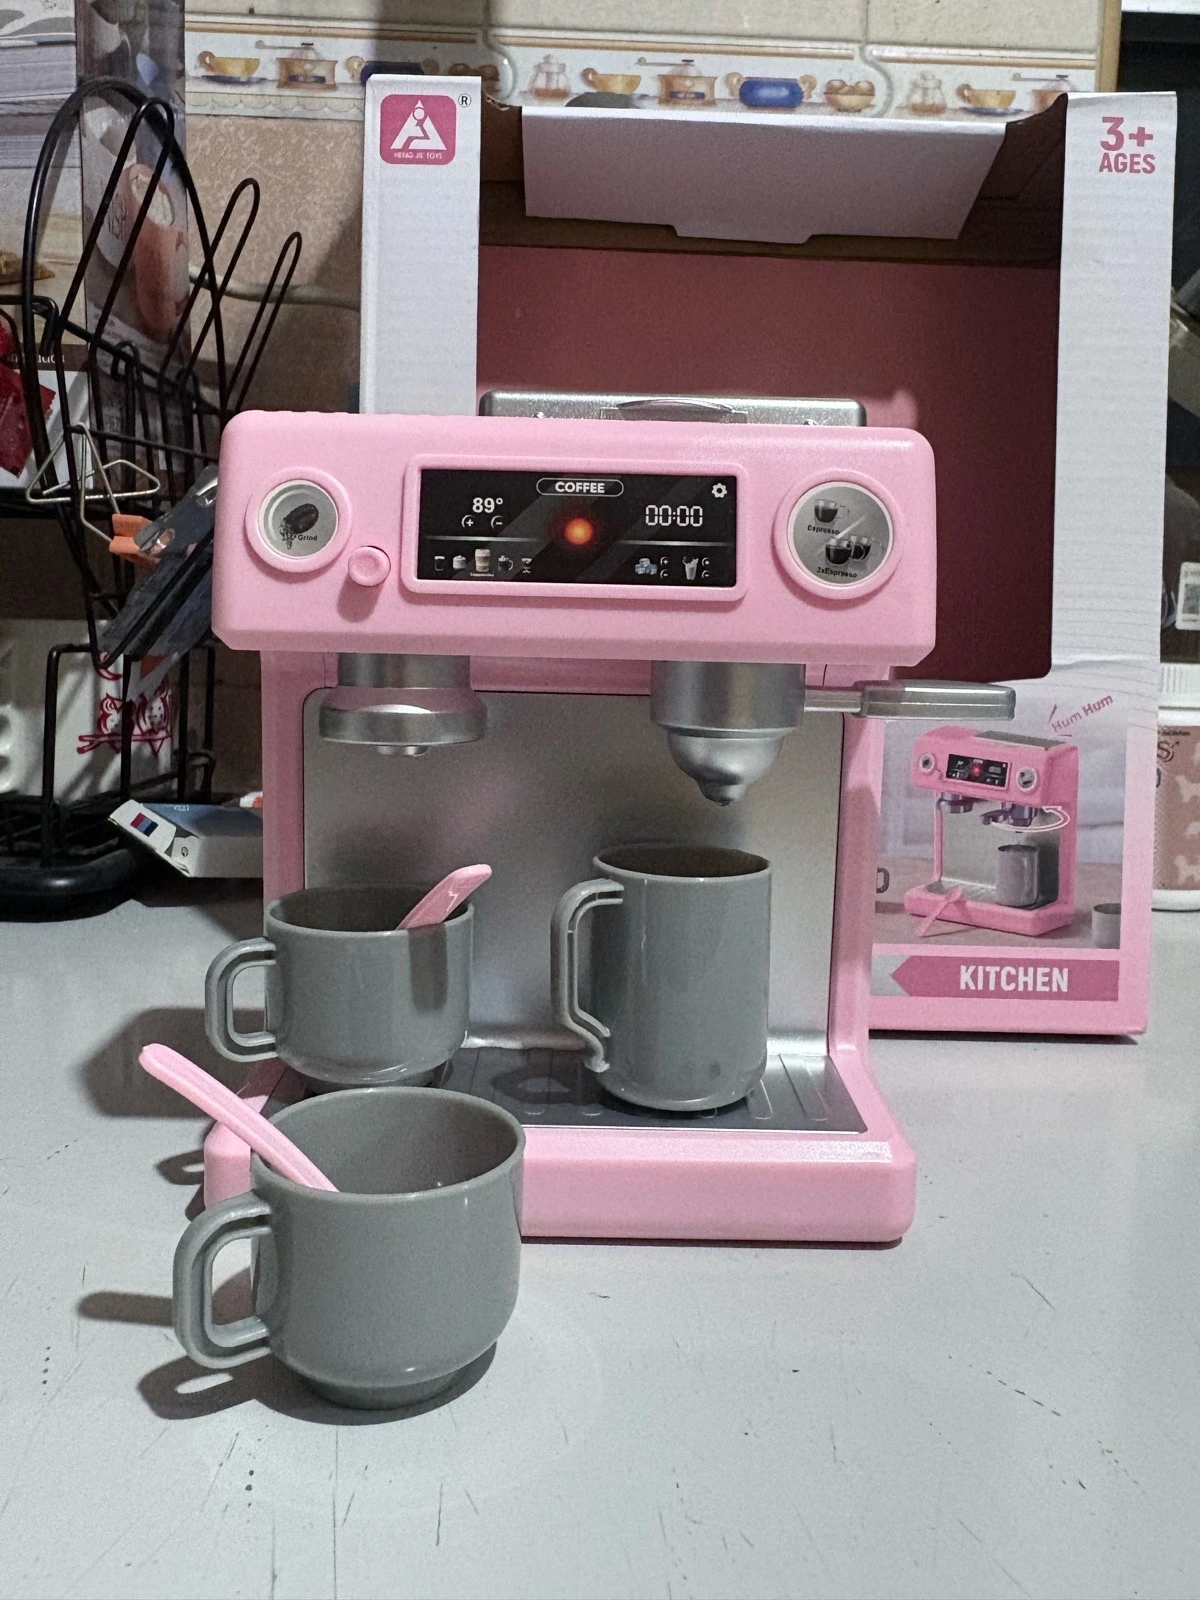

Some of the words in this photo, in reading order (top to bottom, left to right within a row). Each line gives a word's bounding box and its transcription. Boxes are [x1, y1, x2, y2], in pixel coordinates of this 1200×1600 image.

[1100, 116, 1153, 151] 3+
[1099, 152, 1156, 174] AGES
[555, 481, 605, 493] COFFEE
[472, 497, 504, 513] 89°
[645, 504, 703, 527] 00:00
[1051, 712, 1082, 733] Hum
[1081, 695, 1114, 716] Hum
[960, 965, 1069, 993] KITCHEN
